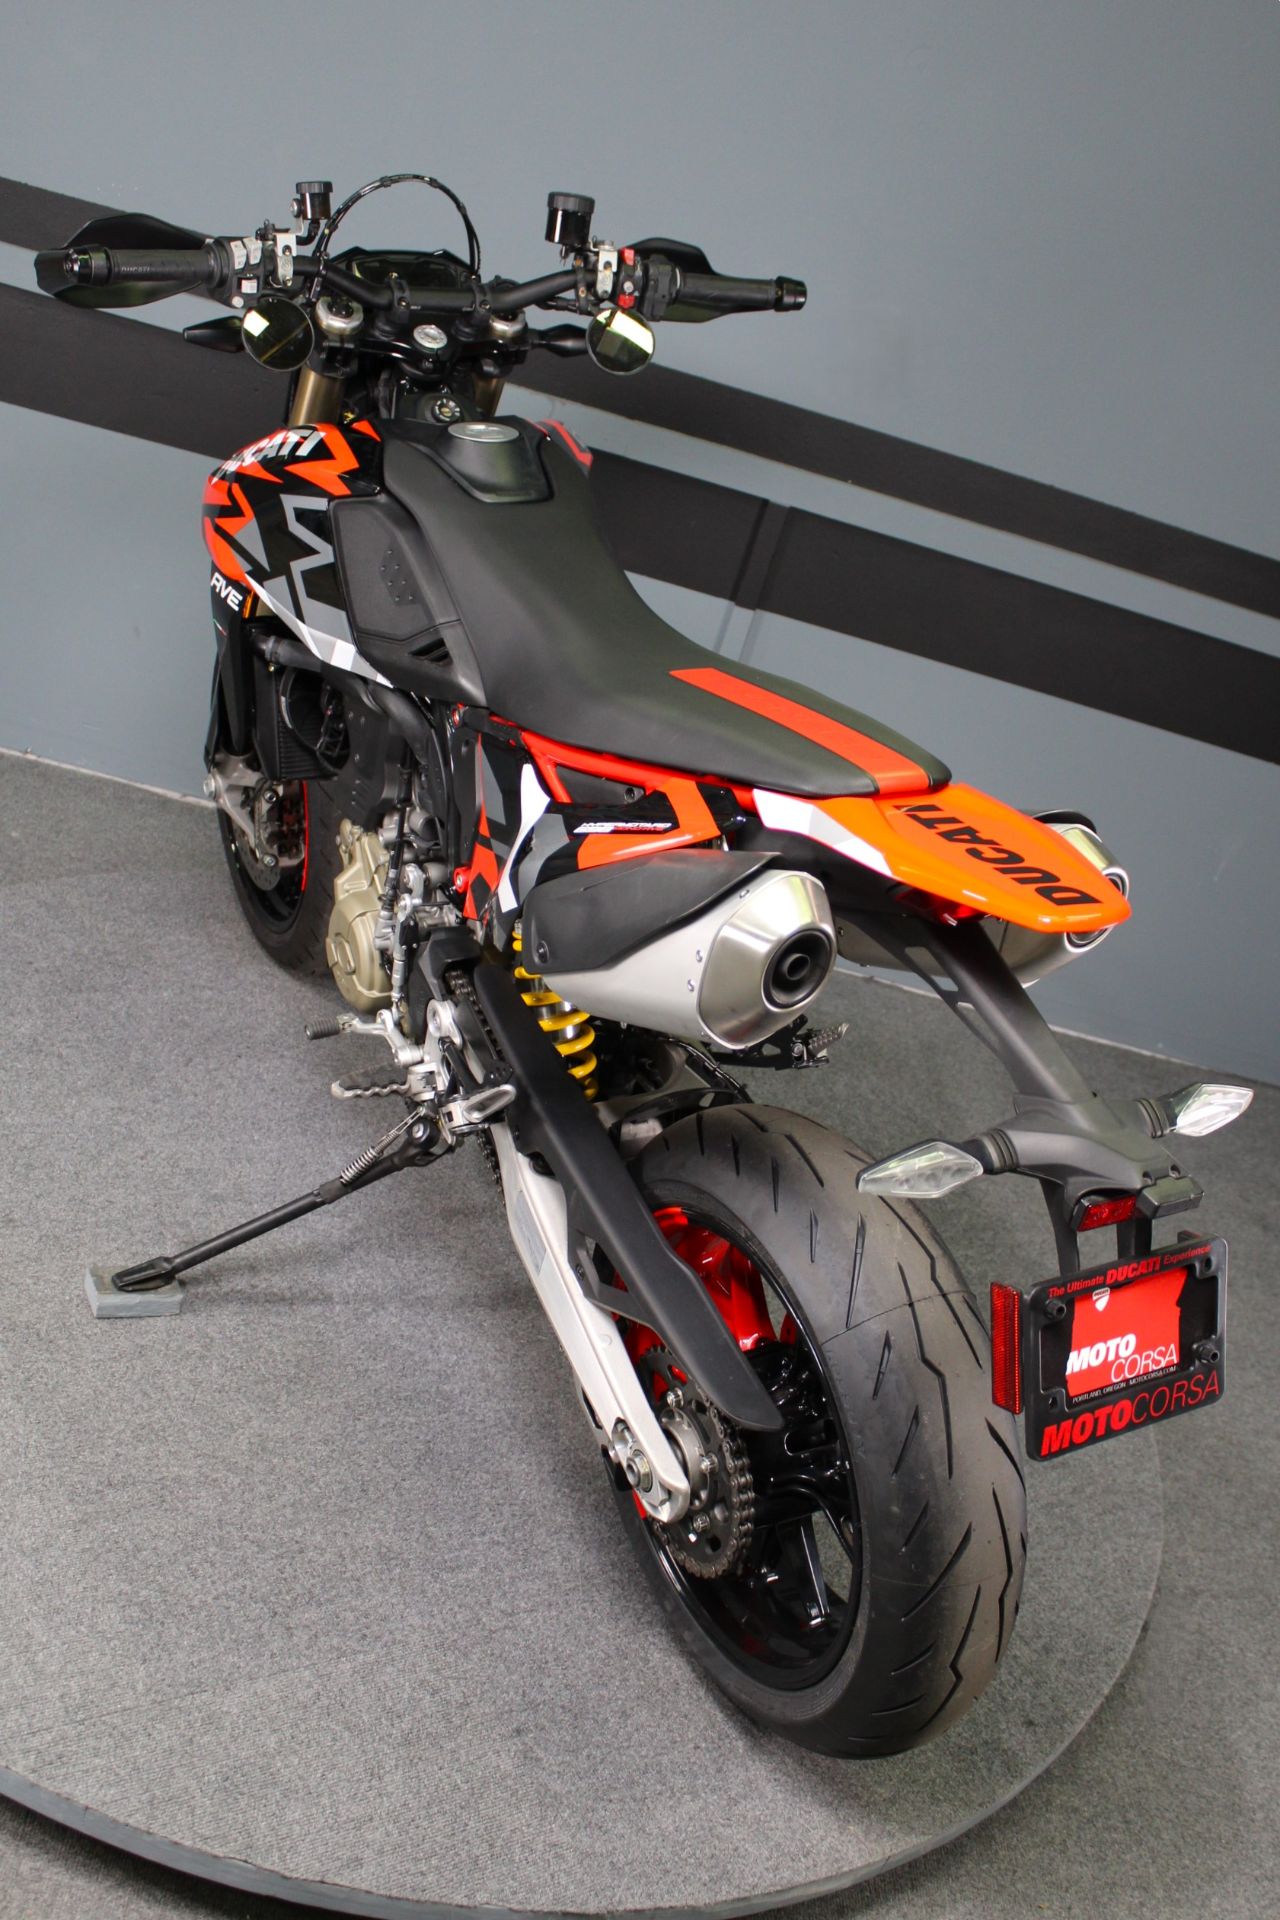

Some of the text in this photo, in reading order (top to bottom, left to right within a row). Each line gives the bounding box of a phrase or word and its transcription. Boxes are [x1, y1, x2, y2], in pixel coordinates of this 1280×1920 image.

[210, 571, 243, 611] RVE
[892, 804, 1104, 906] DUCATI
[1048, 1243, 1212, 1298] The Ultimate DUCATI Experience
[1066, 1333, 1137, 1375] MOTO
[1111, 1343, 1178, 1383] CORSA
[1103, 1382, 1127, 1394] OREGON
[1040, 1369, 1221, 1457] MOTOCORSA
